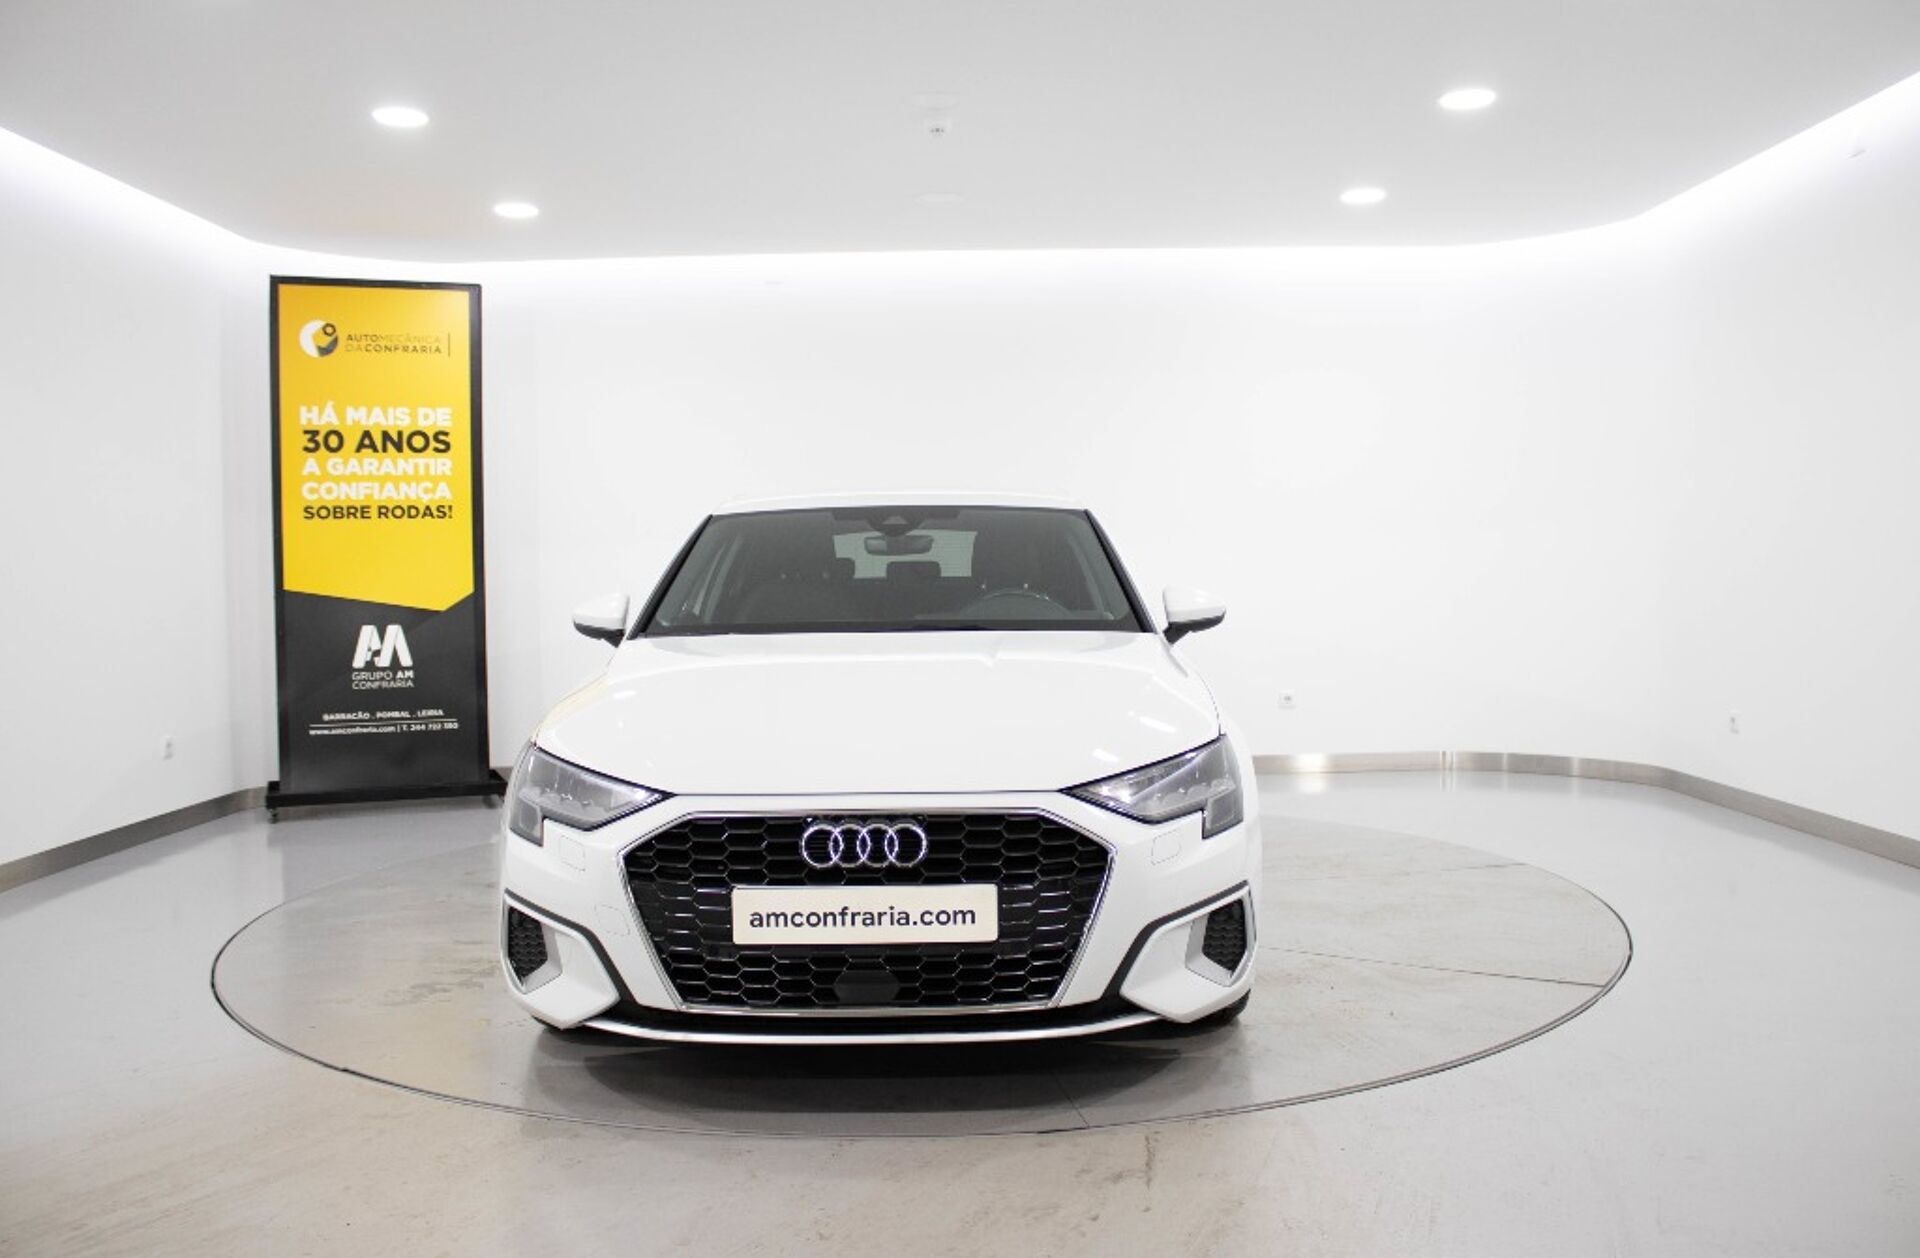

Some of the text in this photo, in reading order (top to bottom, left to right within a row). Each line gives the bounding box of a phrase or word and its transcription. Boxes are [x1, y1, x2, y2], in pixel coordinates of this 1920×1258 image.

[299, 401, 453, 426] HÁ MAIS DE
[303, 430, 451, 453] 30 ANOS
[302, 458, 452, 476] A GARANTIR
[301, 481, 453, 503] CONFIANÇA
[303, 505, 453, 519] SOBRE RODAS!
[352, 670, 415, 681] GRUPO AM
[352, 679, 415, 690] CONFRARIA
[376, 711, 411, 719] POMBAL
[750, 906, 976, 928] amconfraria.com
